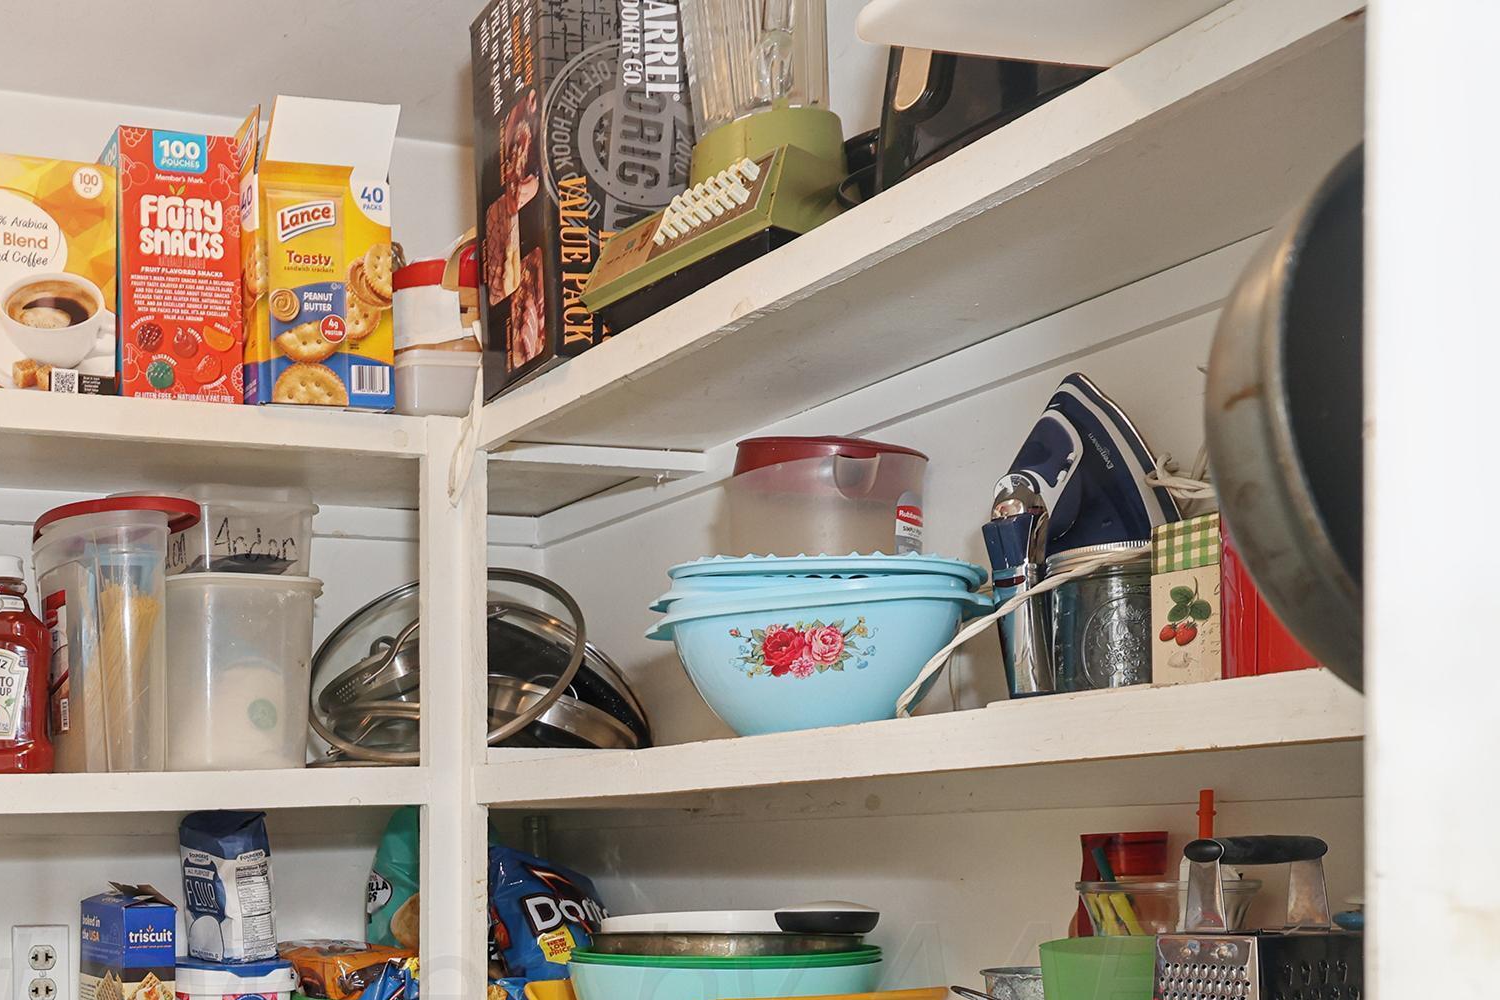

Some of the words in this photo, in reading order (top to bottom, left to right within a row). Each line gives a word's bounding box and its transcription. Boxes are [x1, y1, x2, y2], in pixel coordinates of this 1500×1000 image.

[490, 6, 501, 38] PBJ
[490, 39, 500, 62] up
[503, 28, 513, 64] PBC
[512, 15, 523, 75] capacity
[504, 64, 511, 82] or
[582, 59, 612, 91] OFF
[514, 75, 525, 95] of
[492, 74, 504, 116] notch
[556, 82, 589, 119] THE
[159, 140, 201, 161] 100
[551, 117, 573, 172] HOOK
[161, 158, 201, 170] POUCHES
[78, 172, 99, 187] 100
[155, 173, 187, 184] Member's
[361, 187, 384, 204] 40
[11, 217, 49, 230] Arabica
[280, 206, 333, 232] Lance
[558, 176, 590, 264] VALUE
[3, 231, 49, 250] Blend
[12, 251, 49, 268] Coffee
[286, 250, 332, 266] Toasty
[161, 267, 196, 276] FLAVORED
[303, 292, 333, 302] PEANUT
[304, 302, 333, 312] BUTTER
[561, 269, 595, 346] PACK
[328, 320, 339, 329] 4g
[135, 391, 157, 399] GLUTEN
[178, 393, 209, 402] NATURALLY
[221, 395, 235, 403] FREE
[185, 879, 220, 911] FLOUR
[89, 930, 100, 942] USA
[129, 927, 173, 943] triscuit
[546, 938, 566, 946] NEW
[550, 943, 567, 952] LOW
[550, 946, 572, 957] PRICE
